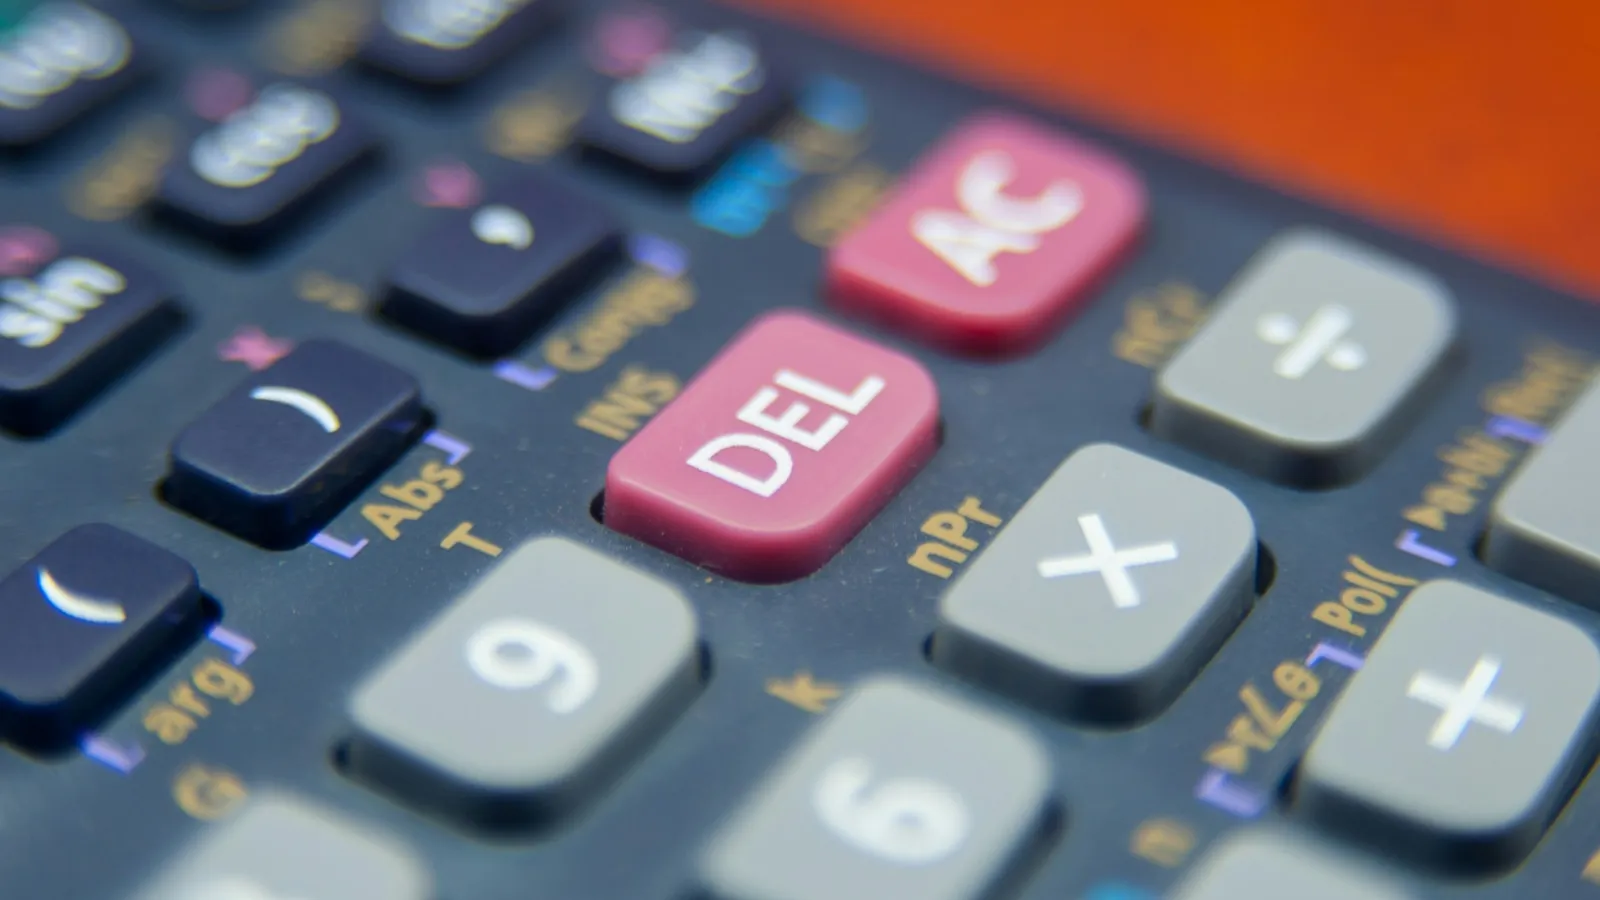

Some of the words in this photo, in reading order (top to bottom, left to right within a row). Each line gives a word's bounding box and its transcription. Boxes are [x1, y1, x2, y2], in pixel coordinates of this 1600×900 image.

[908, 151, 1084, 287] AC
[0, 256, 127, 348] sin
[575, 365, 682, 442] INS
[685, 369, 886, 498] DEL
[361, 461, 465, 541] Abs
[440, 522, 503, 557] T
[908, 496, 1002, 579] nPr
[1311, 554, 1419, 637] Pol(
[144, 657, 255, 746] arg
[465, 617, 598, 715] 9
[1406, 653, 1525, 752] +
[813, 755, 968, 863] 6
